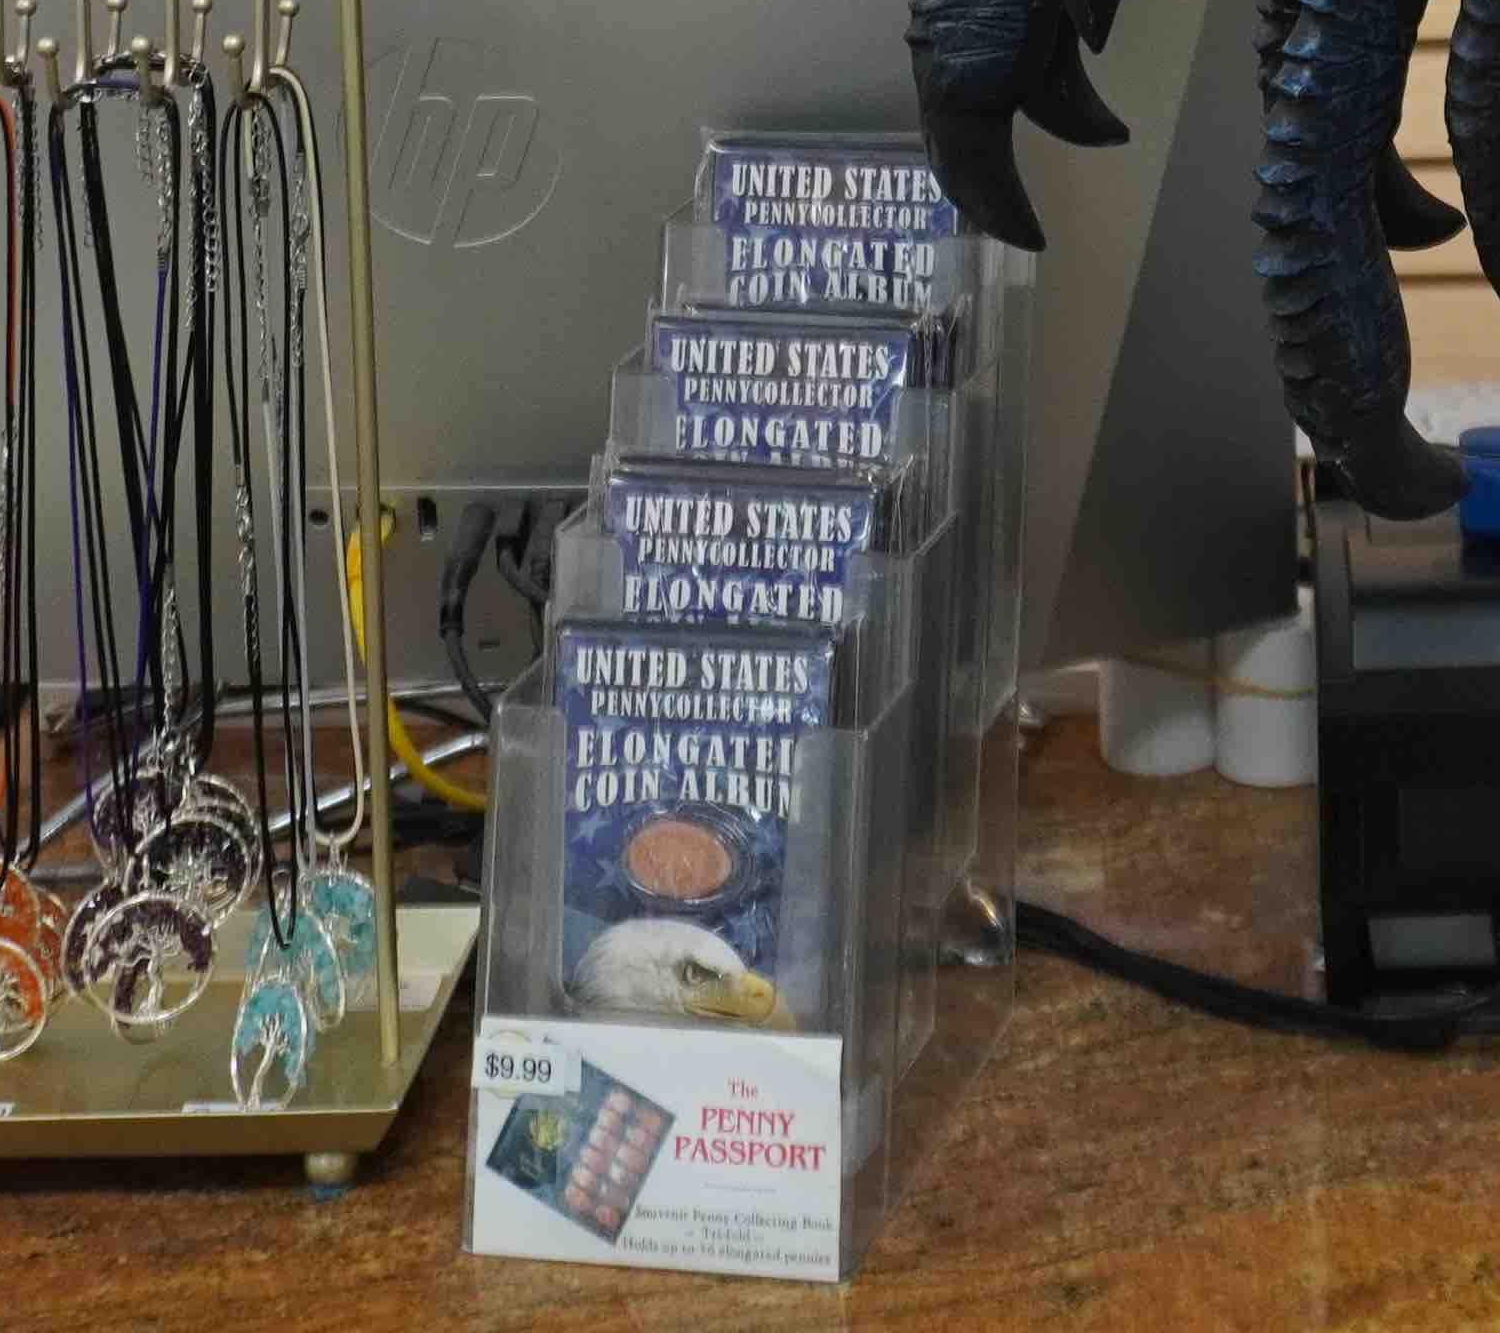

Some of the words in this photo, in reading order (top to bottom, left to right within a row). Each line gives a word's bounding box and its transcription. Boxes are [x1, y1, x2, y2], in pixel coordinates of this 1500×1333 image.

[731, 163, 833, 200] UNITED
[844, 166, 943, 204] STATES
[743, 199, 929, 231] PENNYCOLLECTOR
[731, 235, 936, 279] ELONGATED
[728, 270, 811, 311] COIN
[823, 268, 934, 313] ALBUM
[670, 337, 776, 377] UNITED
[787, 340, 890, 381] STATES
[683, 376, 874, 409] PENNYCOLLECTOR
[675, 414, 883, 459] ELONGATED
[625, 495, 735, 537] UNITED
[746, 501, 853, 544] STATES
[637, 535, 836, 573] PENNYCOLLECTOR
[622, 573, 844, 624] ELONGATED
[575, 646, 688, 689] UNITED
[700, 650, 809, 694] STATES
[590, 689, 793, 725] PENNYCOLLECTOR
[574, 768, 661, 814] COIN
[484, 1052, 553, 1083] $9.99
[727, 1077, 758, 1100] The
[700, 1106, 796, 1138] PENNY
[674, 1135, 827, 1172] PASSPORT
[692, 1208, 731, 1226] Penny
[734, 1211, 799, 1231] Collecting
[802, 1215, 834, 1231] Book
[620, 1235, 660, 1255] Holds
